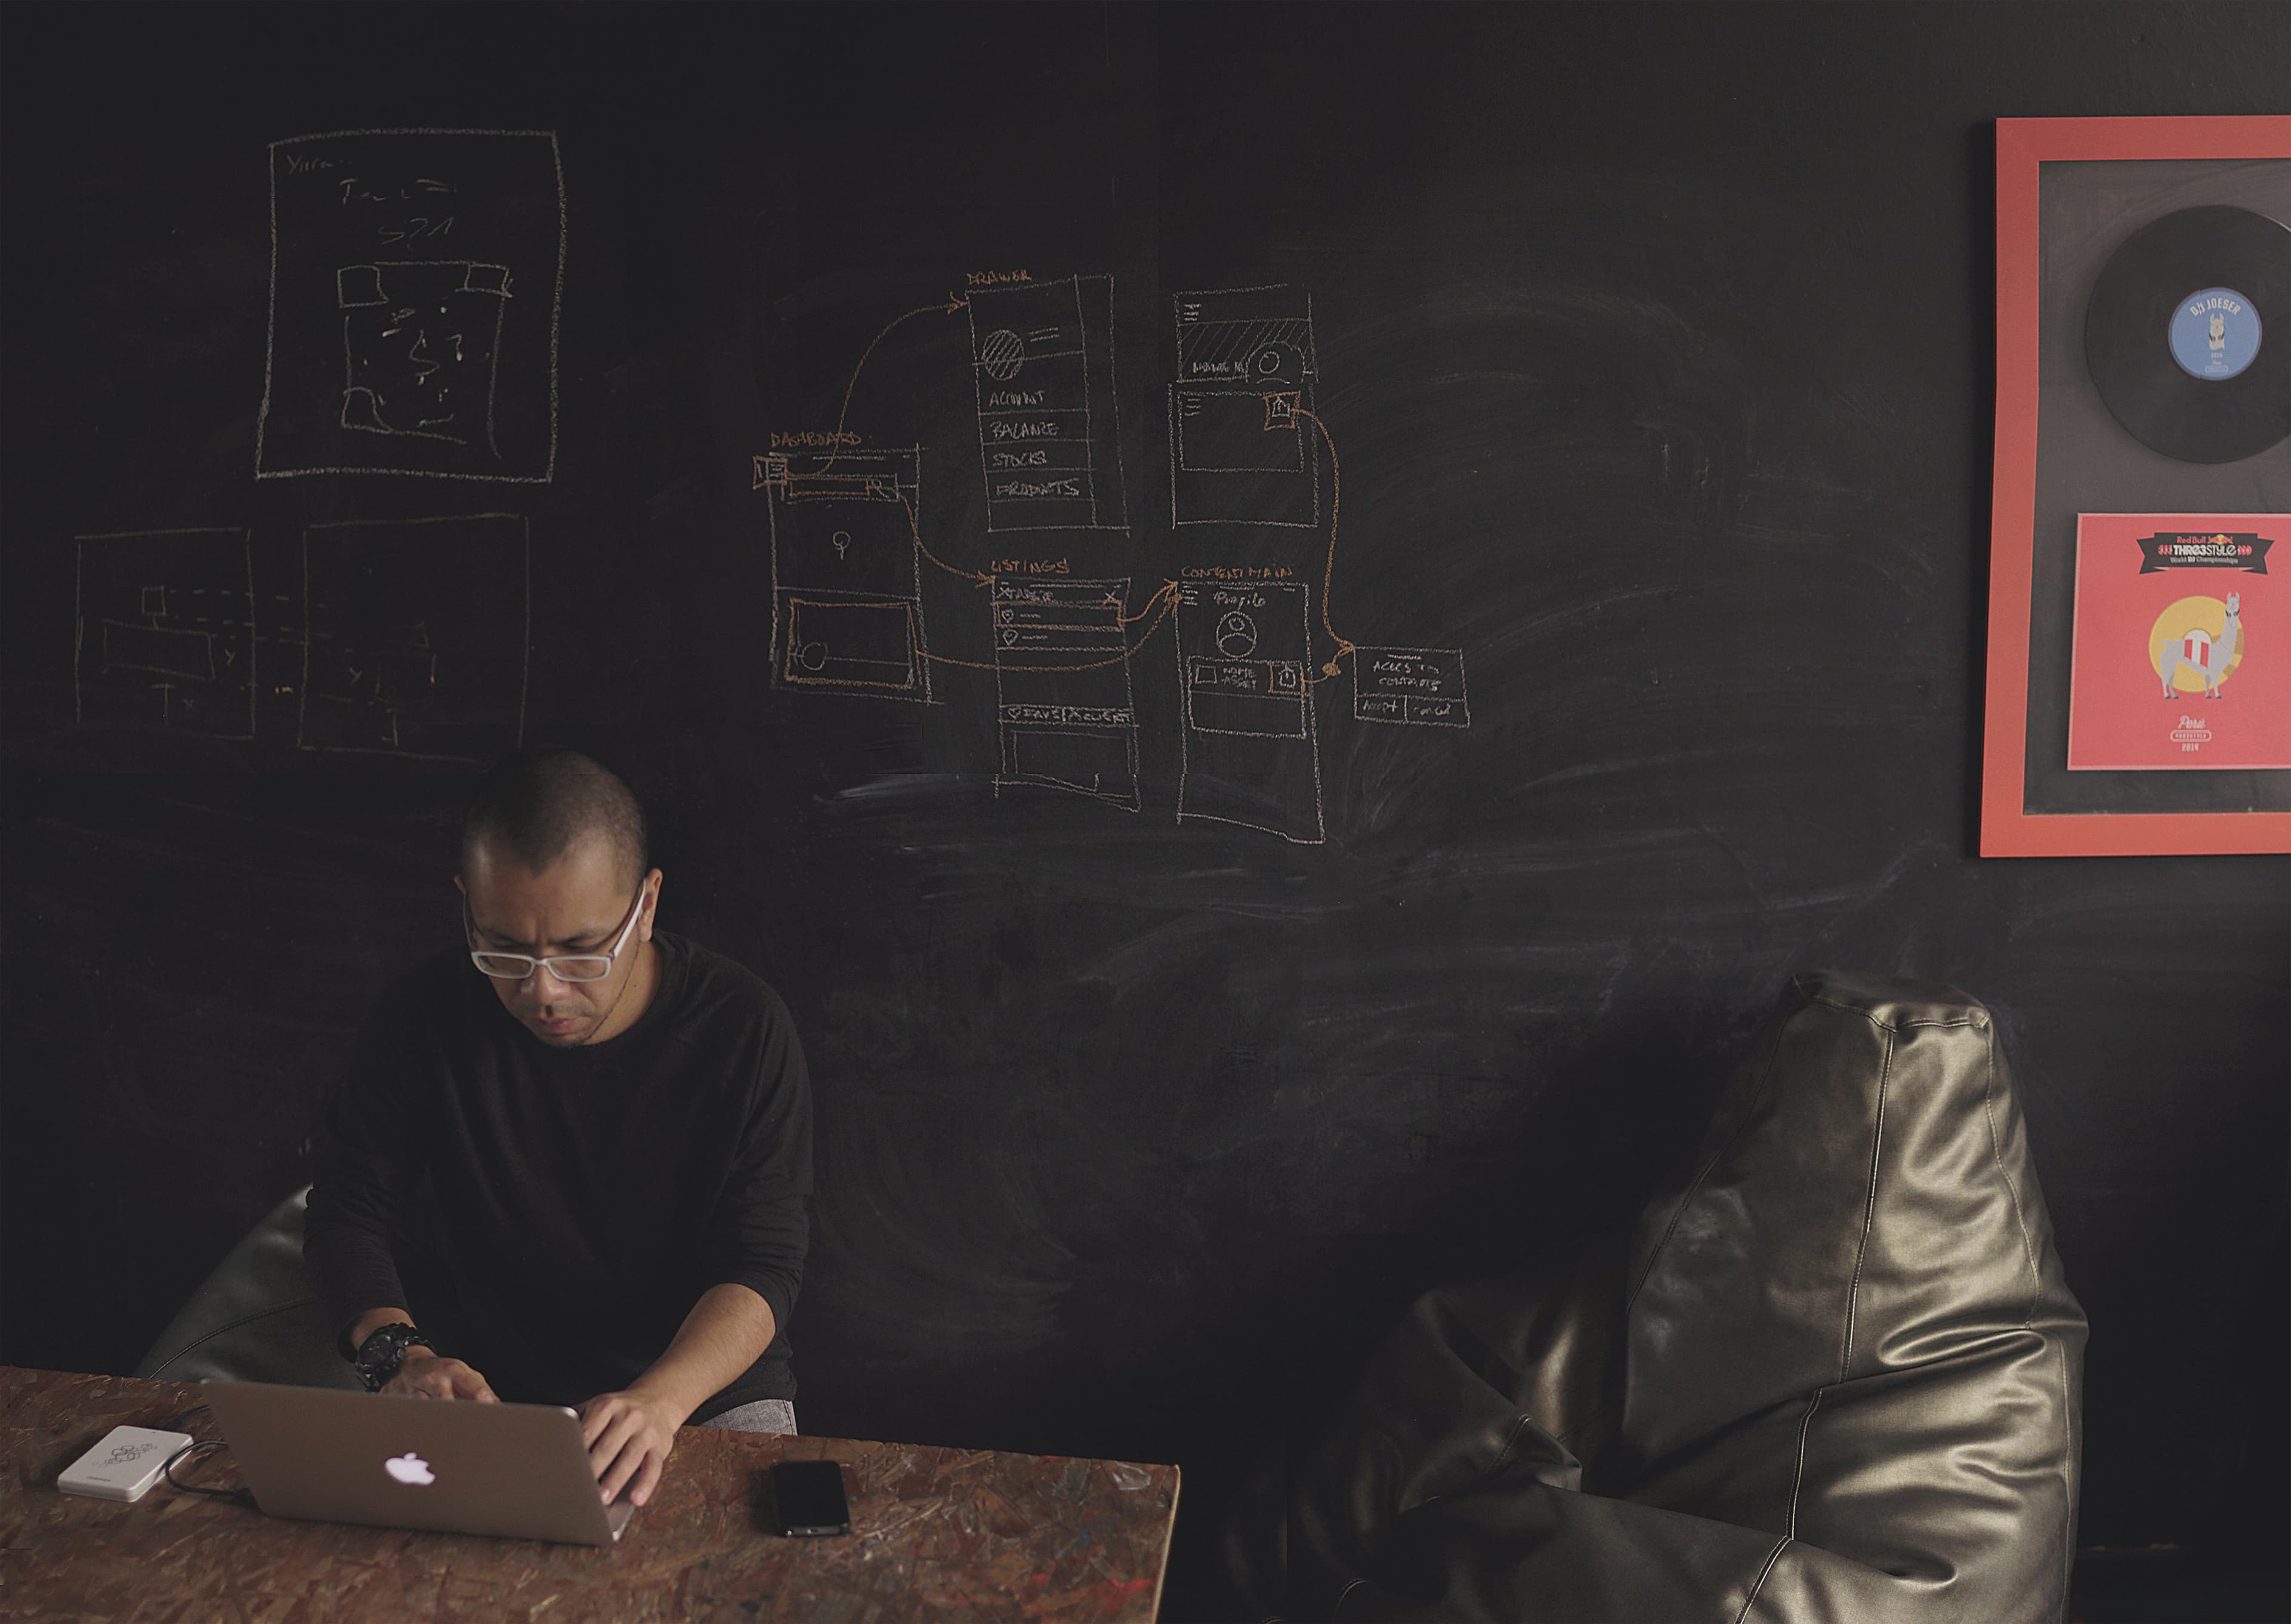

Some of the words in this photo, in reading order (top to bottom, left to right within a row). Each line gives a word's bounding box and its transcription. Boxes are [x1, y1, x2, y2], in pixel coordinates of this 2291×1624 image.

[967, 269, 1032, 285] DRAWER
[2207, 298, 2241, 315] JOESER
[990, 421, 1059, 439] BALANCE
[770, 431, 863, 447] DASHBOARD
[991, 557, 1070, 573] LISTINGS
